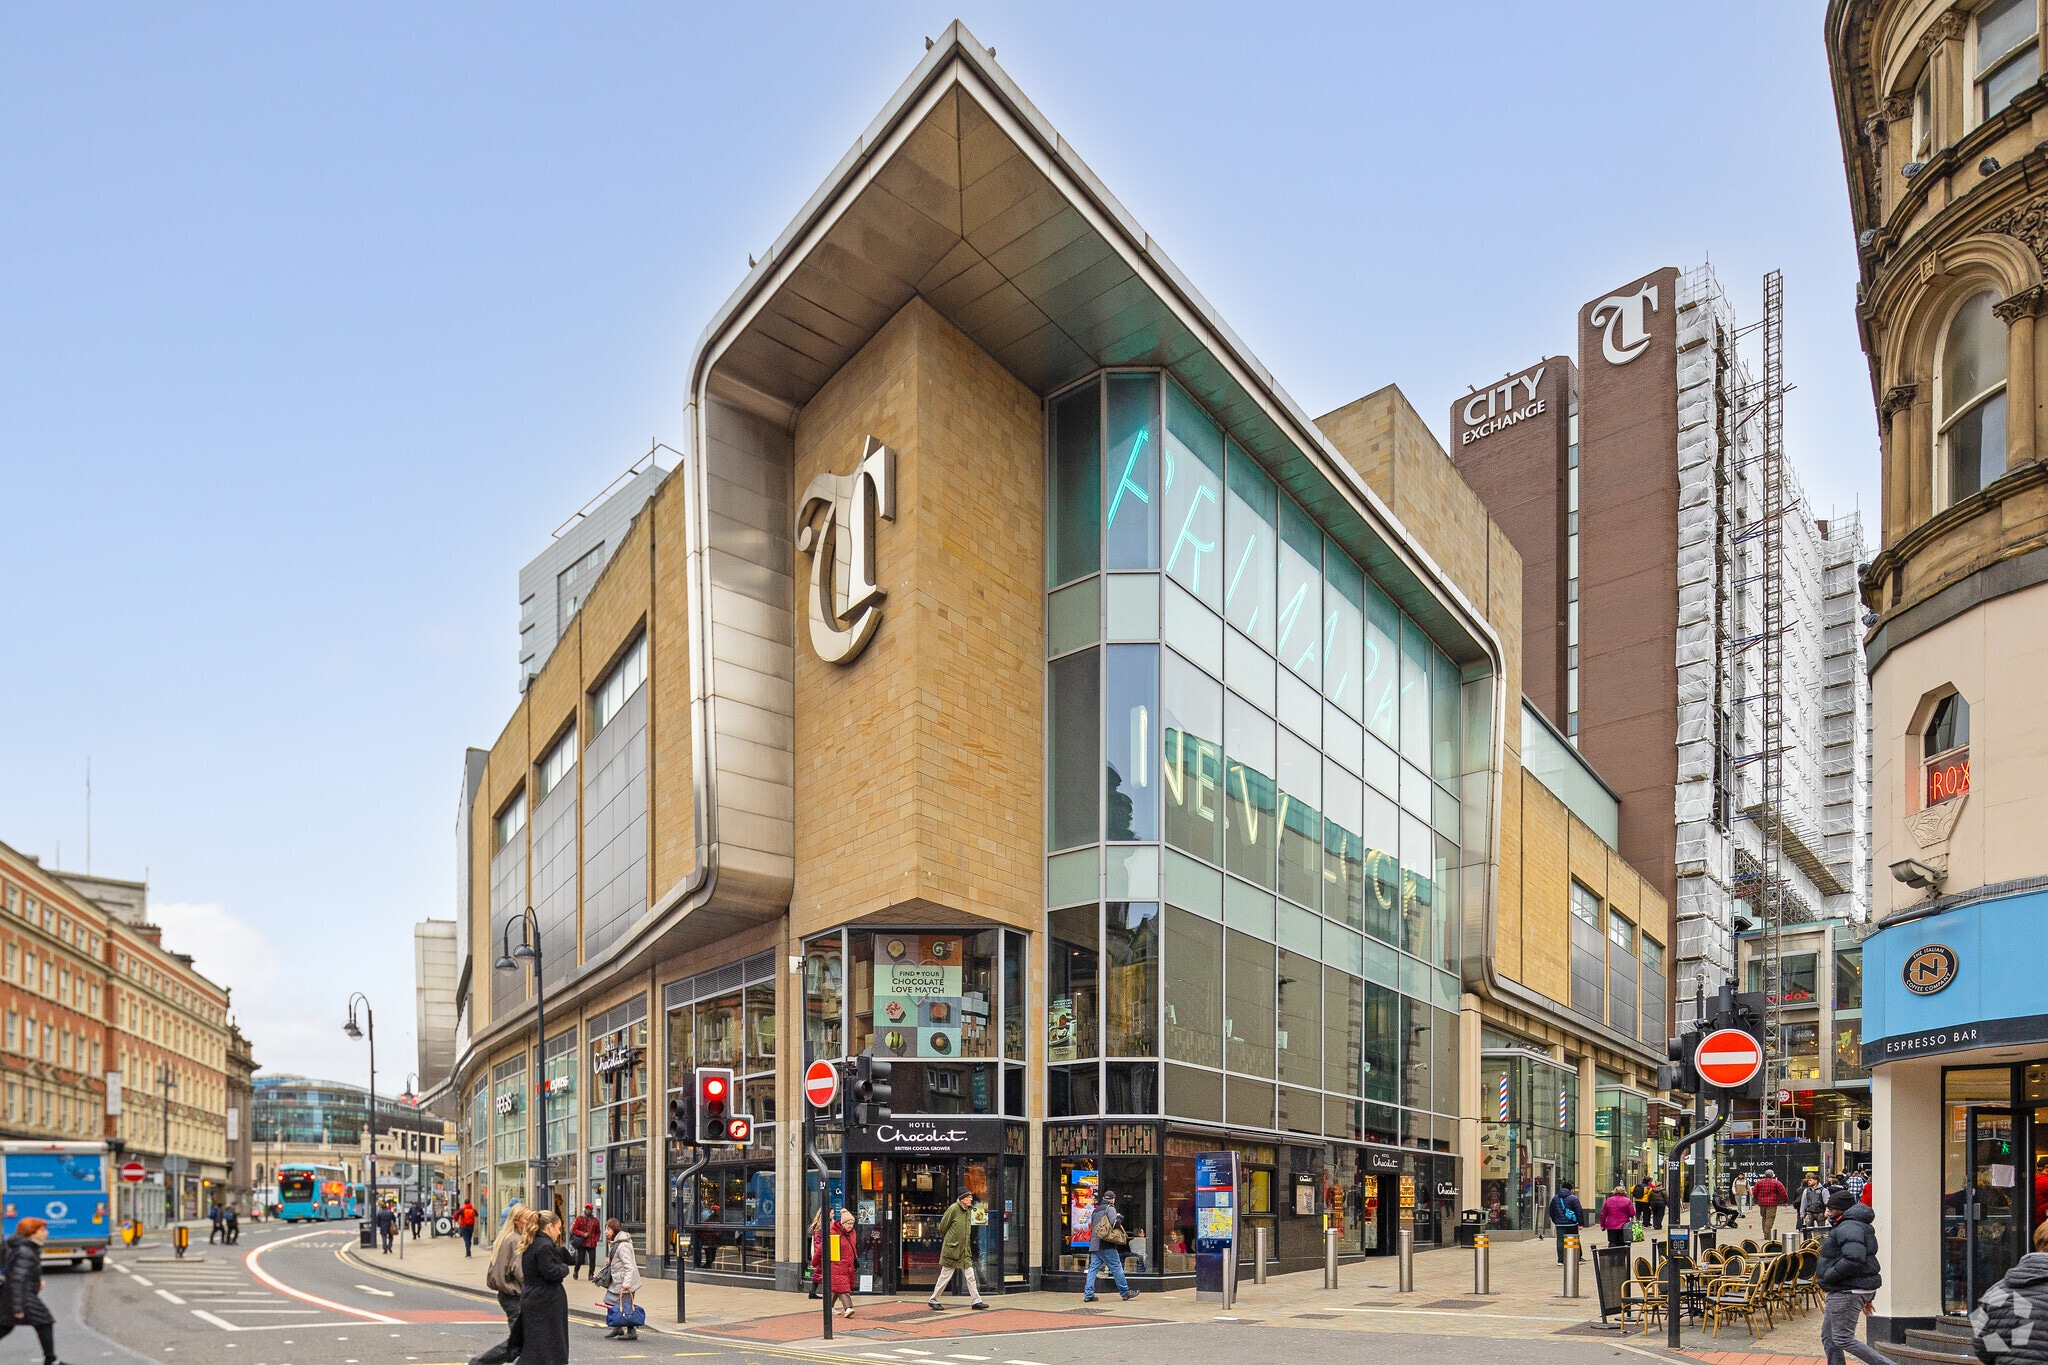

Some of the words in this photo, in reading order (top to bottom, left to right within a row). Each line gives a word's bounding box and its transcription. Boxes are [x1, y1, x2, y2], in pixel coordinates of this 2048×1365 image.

[1463, 367, 1545, 426] CITY
[1462, 399, 1546, 445] EXCHANGE
[892, 977, 945, 986] CHOCOLATE
[914, 986, 945, 994] MATCH
[1906, 979, 1924, 992] COFFEE
[1924, 973, 1951, 991] COMPANY
[1886, 1034, 1947, 1053] ESPRESSO
[1953, 1029, 1977, 1042] BAR
